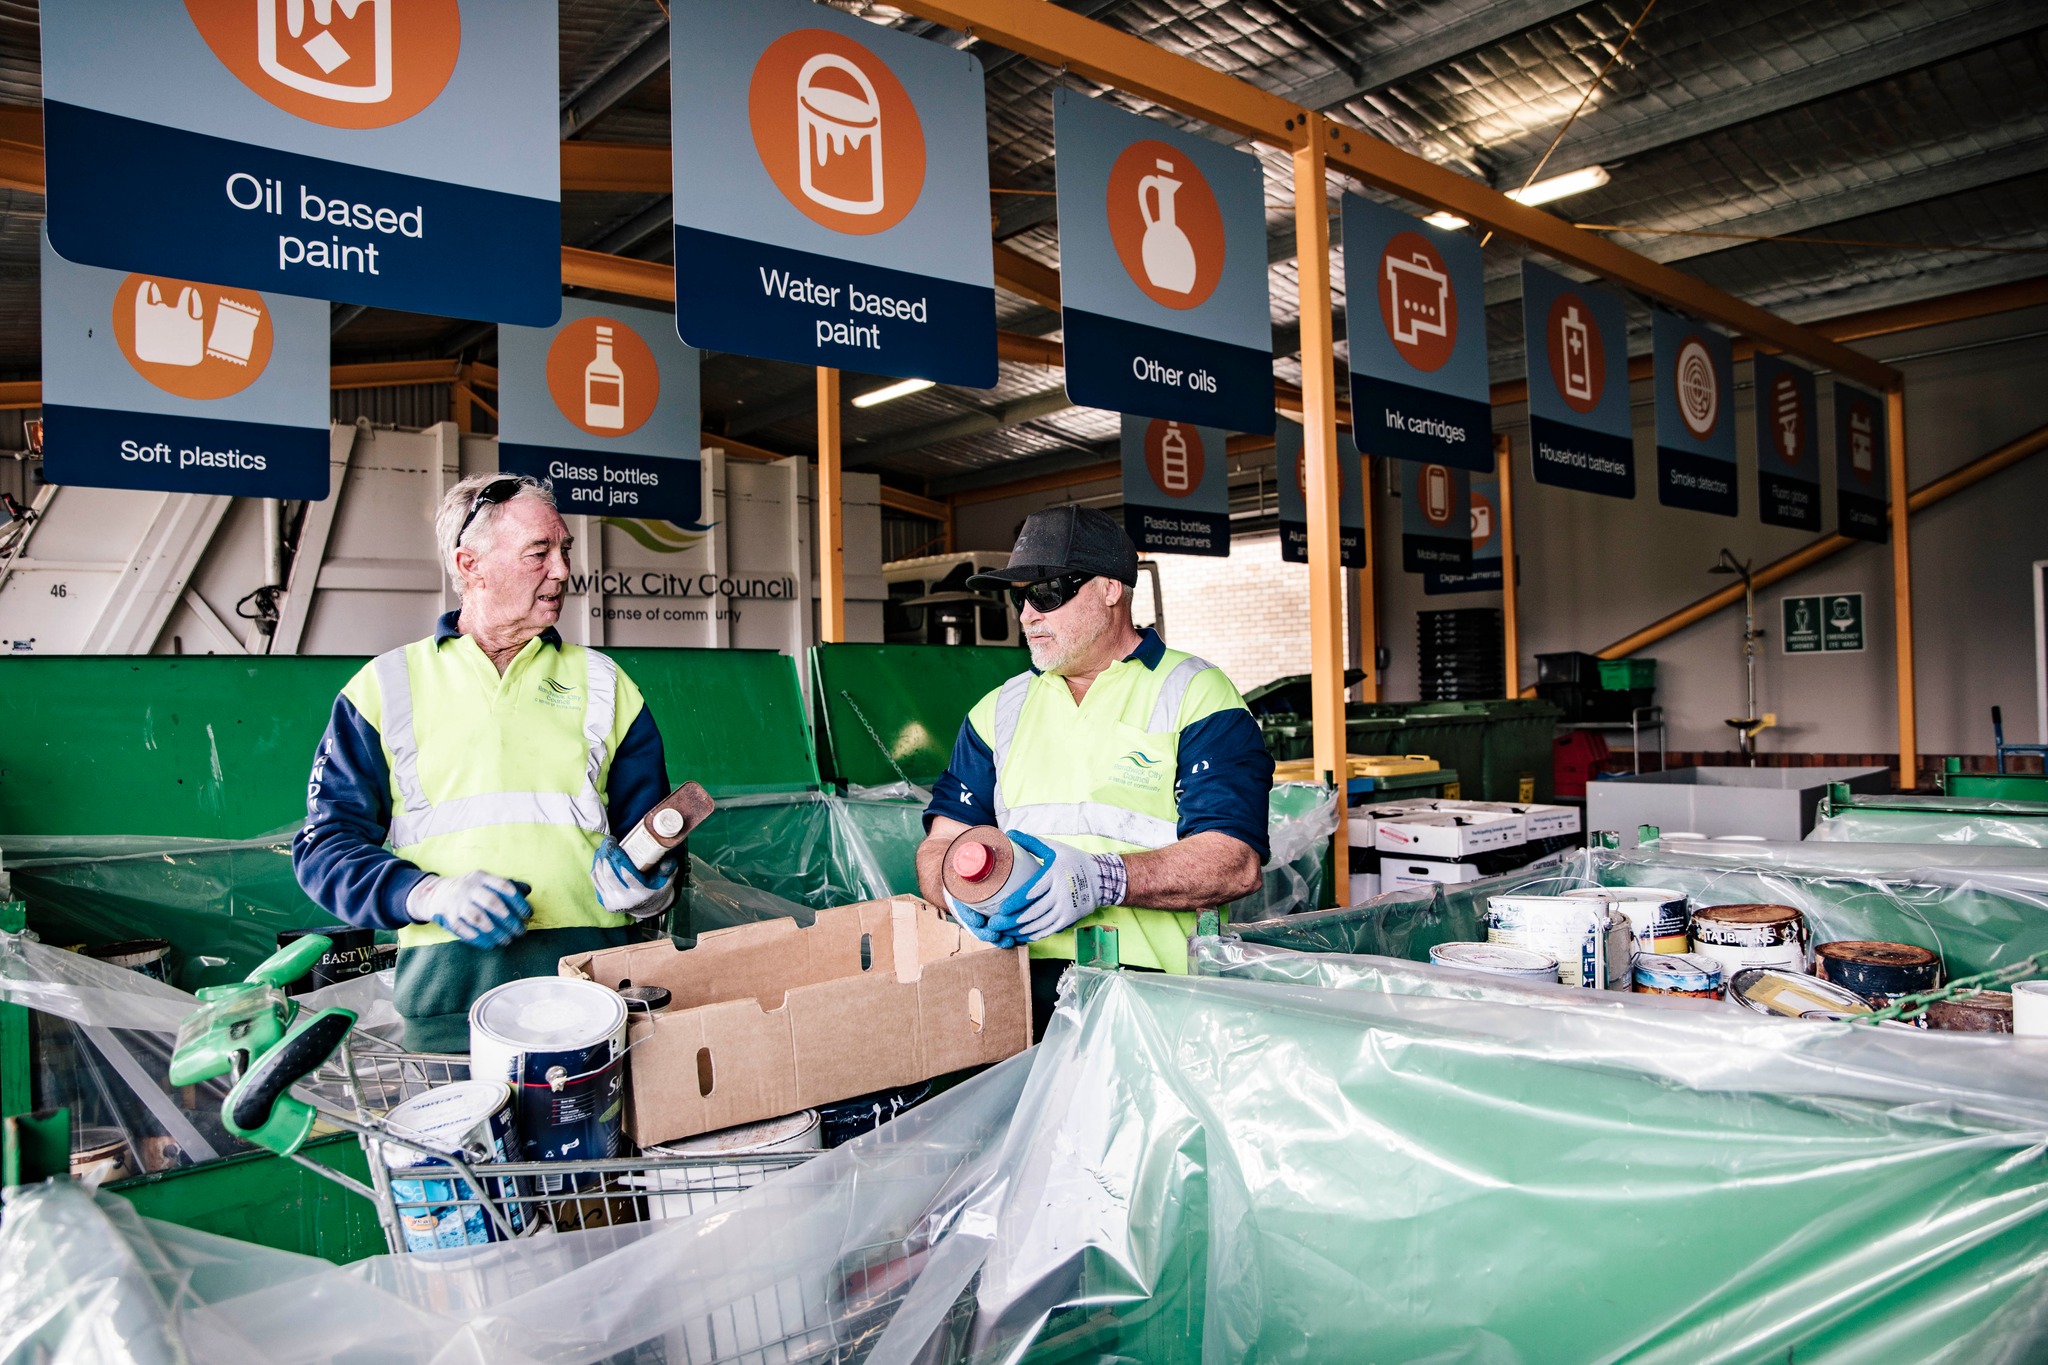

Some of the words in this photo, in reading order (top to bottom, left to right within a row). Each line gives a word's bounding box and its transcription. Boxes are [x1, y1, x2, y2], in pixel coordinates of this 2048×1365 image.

[225, 172, 282, 215] Oil
[300, 184, 424, 238] based
[278, 234, 380, 276] paint
[759, 265, 841, 308] Water
[849, 283, 928, 324] based
[815, 315, 881, 350] paint
[1132, 356, 1184, 387] Other
[1188, 368, 1218, 394] oils
[1385, 408, 1405, 429] Ink
[1408, 416, 1466, 444] cartridges
[120, 439, 172, 464] Soft
[179, 445, 267, 471] plastics
[1539, 442, 1587, 469] Household
[1588, 455, 1626, 476] batteries
[549, 460, 598, 482] Glass
[603, 465, 659, 486] bottles
[1670, 468, 1696, 489] Smoke
[1697, 476, 1728, 495] detectors
[571, 485, 604, 503] and
[608, 486, 639, 507] jars
[1143, 515, 1179, 531] Plastics
[1180, 519, 1212, 534] bottles
[1144, 532, 1163, 544] and
[1164, 535, 1212, 548] containers
[50, 584, 67, 597] 46
[641, 573, 692, 597] City
[698, 574, 793, 598] Council
[591, 607, 601, 618] a
[646, 607, 660, 621] of
